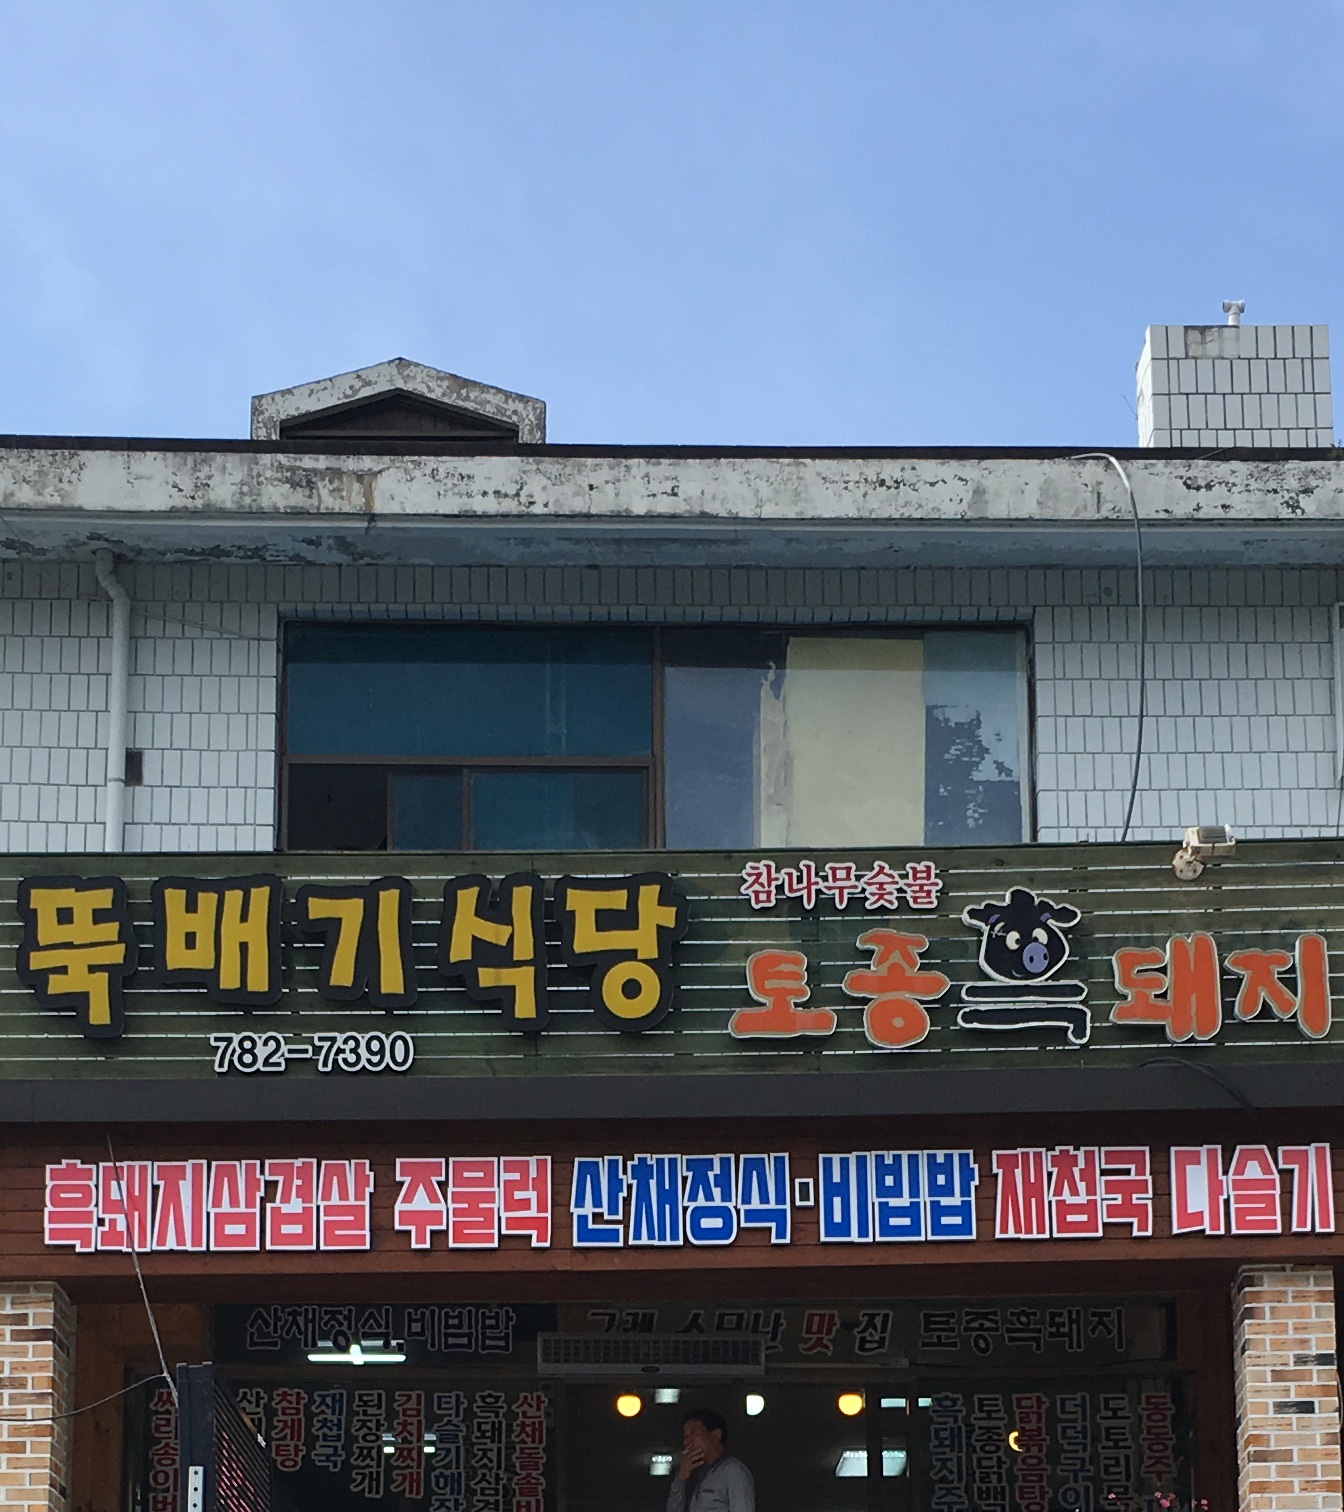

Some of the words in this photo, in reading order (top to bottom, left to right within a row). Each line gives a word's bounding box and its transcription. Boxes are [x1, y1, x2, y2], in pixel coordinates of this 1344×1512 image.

[740, 860, 942, 910] 참나무숯불
[23, 880, 682, 1032] 뚝배기식당
[210, 1031, 414, 1073] 782-7390
[45, 1156, 374, 1253] 흑돼지삼겹살
[394, 1155, 552, 1250] 주물럭
[991, 1145, 1153, 1239] 재첩국
[1169, 1143, 1335, 1237] 다슬기
[918, 1306, 1127, 1356] 토종흑돼지
[271, 1388, 309, 1471] 참게탕
[312, 1389, 346, 1472] 재첩국
[350, 1390, 386, 1498] 된장찌개
[390, 1391, 425, 1498] 김치찌개
[1138, 1392, 1177, 1483] 동동주
